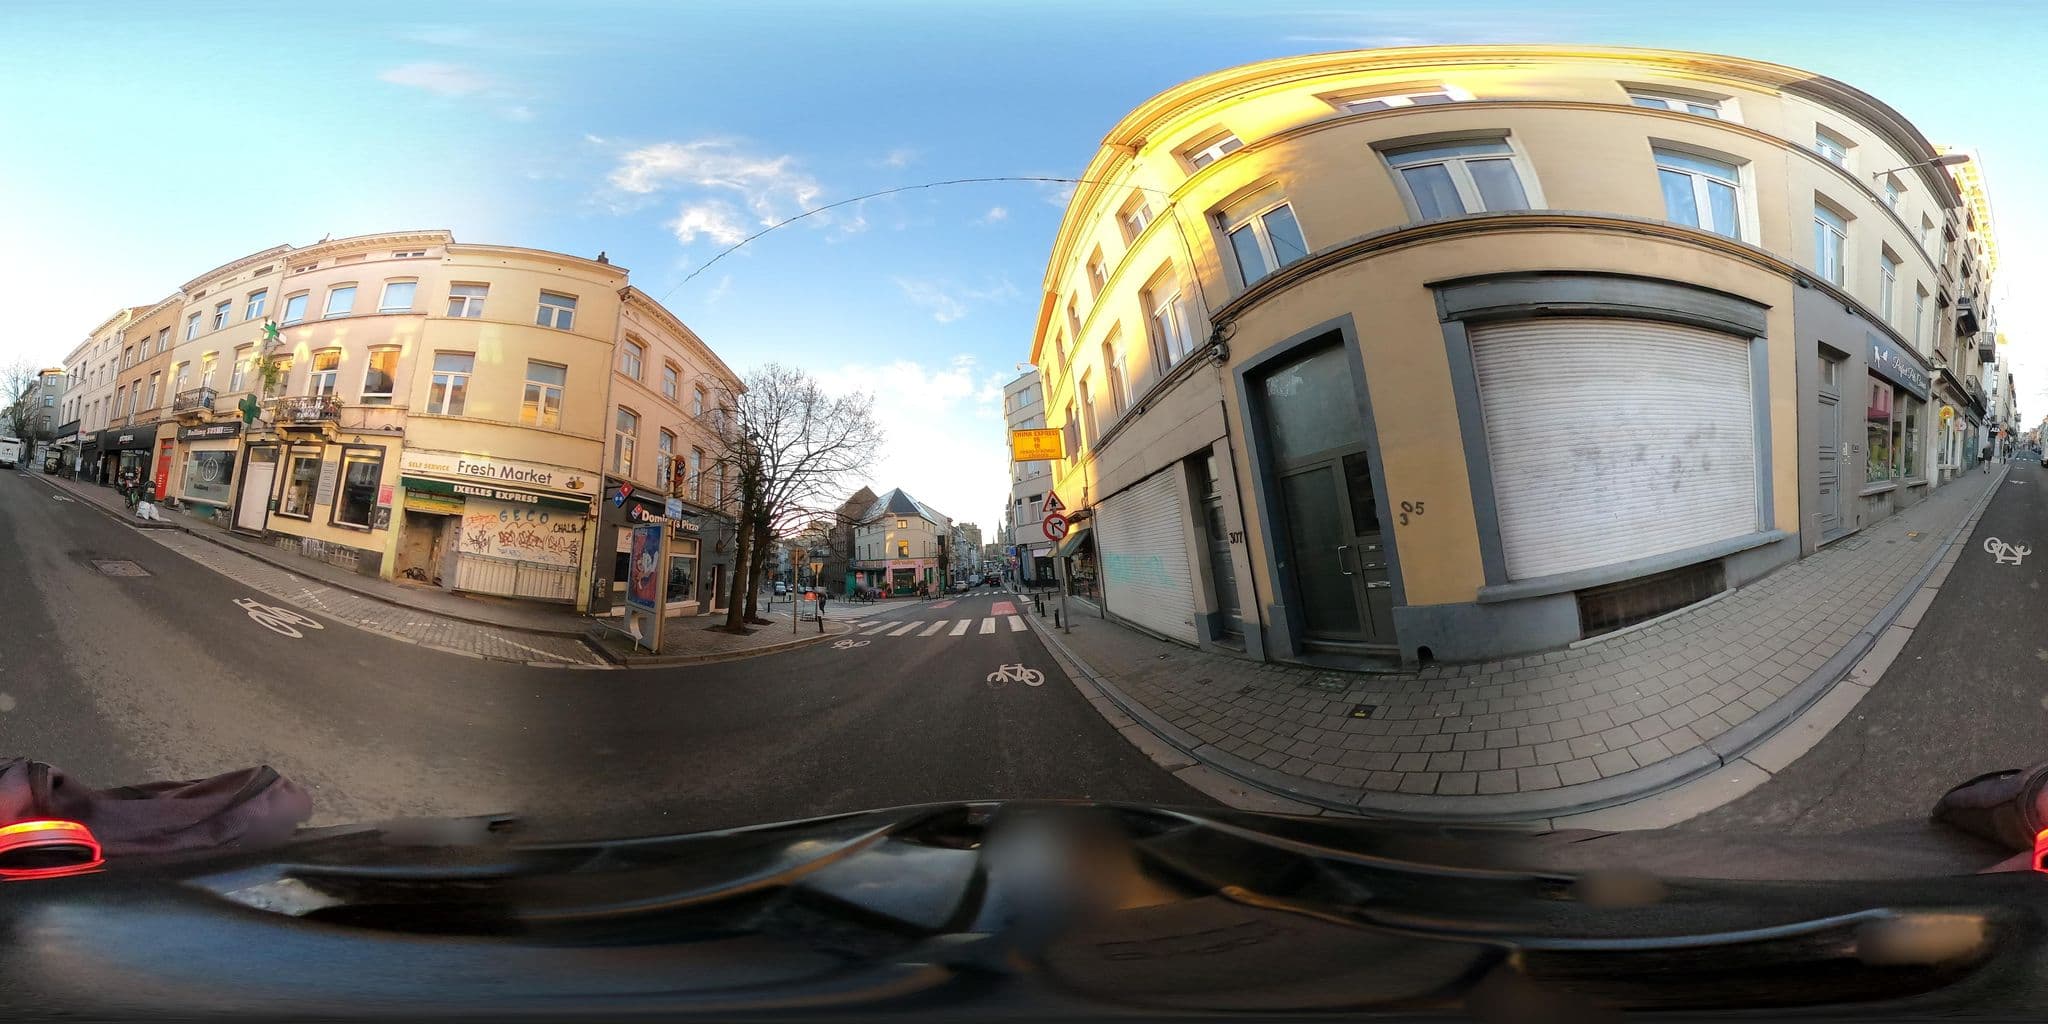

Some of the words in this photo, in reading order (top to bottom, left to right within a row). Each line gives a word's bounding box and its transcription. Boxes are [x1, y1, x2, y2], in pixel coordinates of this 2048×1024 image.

[408, 461, 422, 469] SELF
[423, 463, 450, 472] SERVICE
[457, 460, 496, 477] Fresh
[500, 466, 553, 485] Market
[453, 485, 493, 497] IXELLES
[495, 491, 538, 503] EXPRESS
[681, 519, 699, 532] Pizza
[1229, 531, 1243, 545] 307
